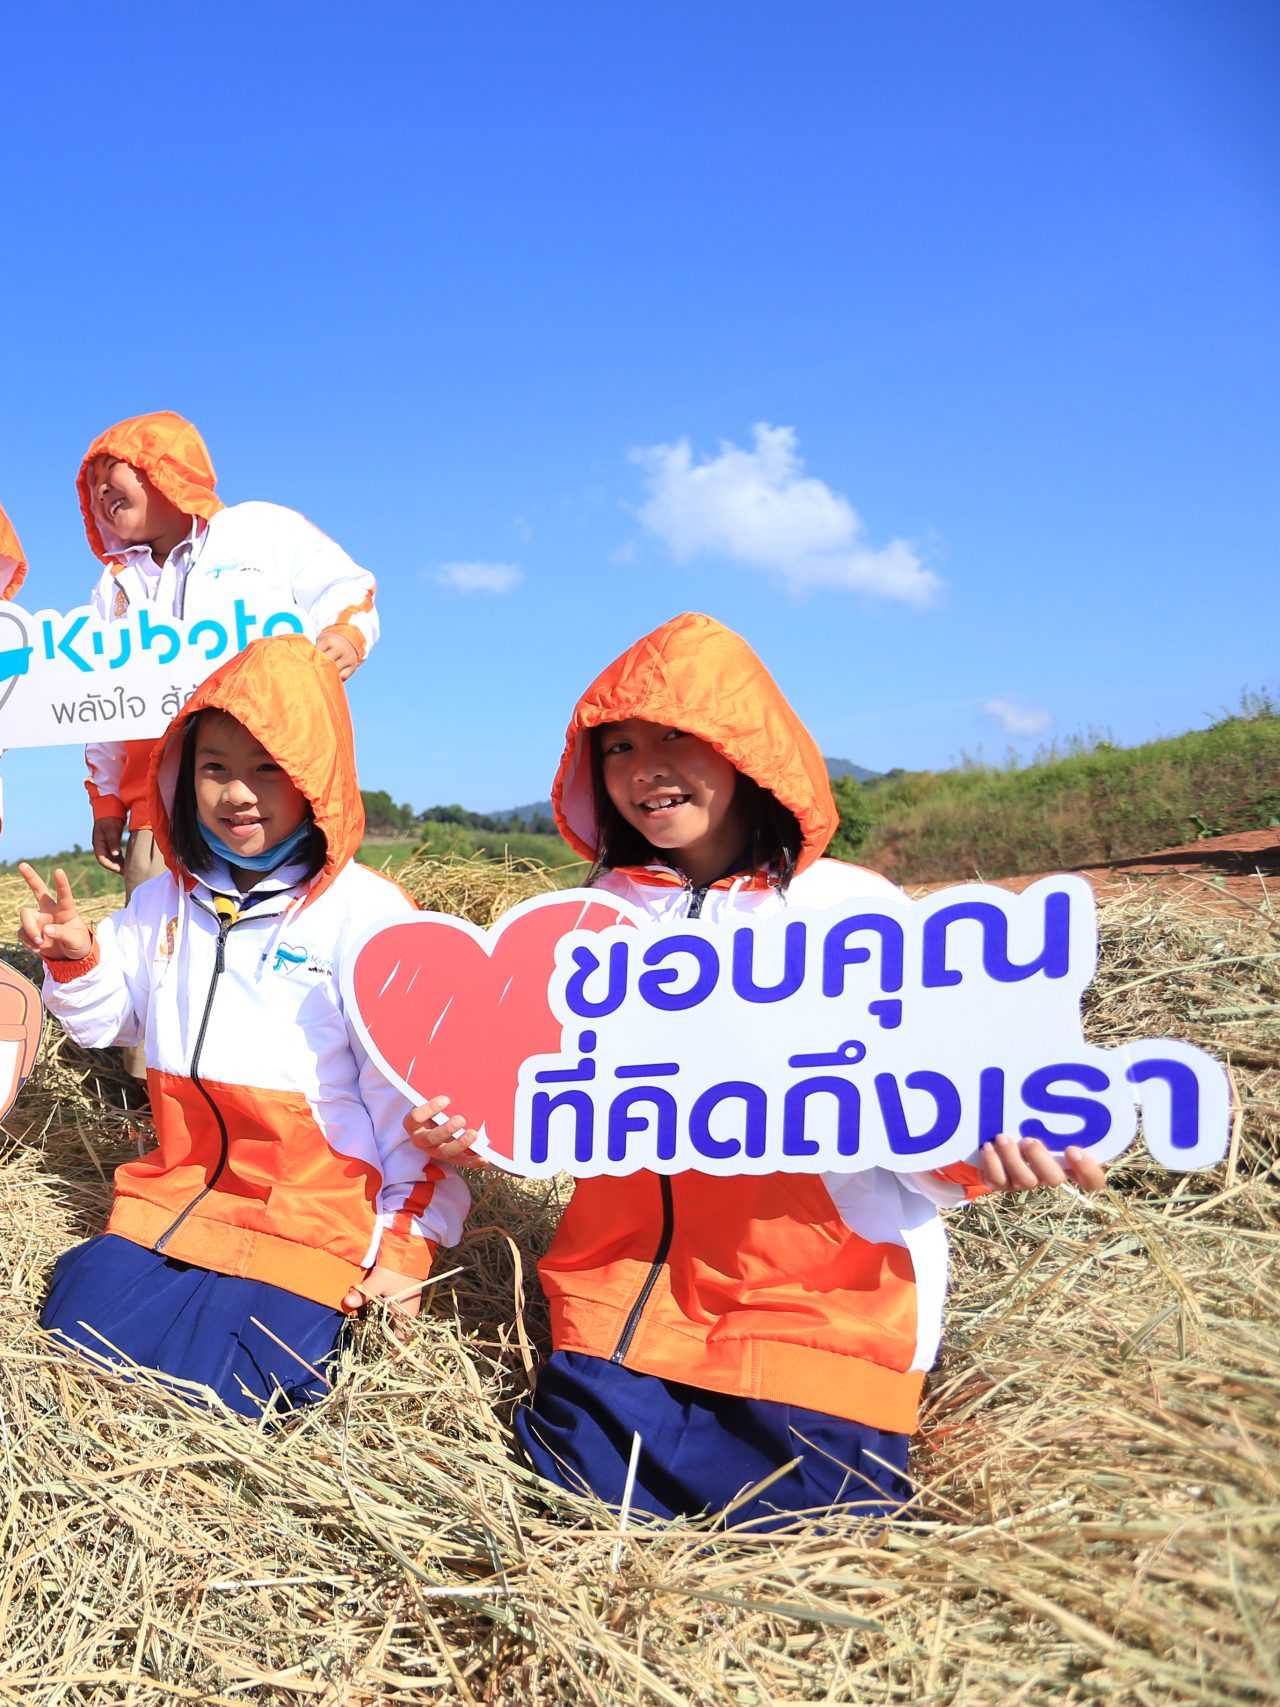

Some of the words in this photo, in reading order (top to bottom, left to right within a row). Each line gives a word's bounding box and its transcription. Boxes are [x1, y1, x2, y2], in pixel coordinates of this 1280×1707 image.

[51, 686, 146, 725] พลังใจ
[565, 891, 1070, 1030] ขอบคุณ
[530, 1029, 1200, 1156] ที่คิดถึงเรา
